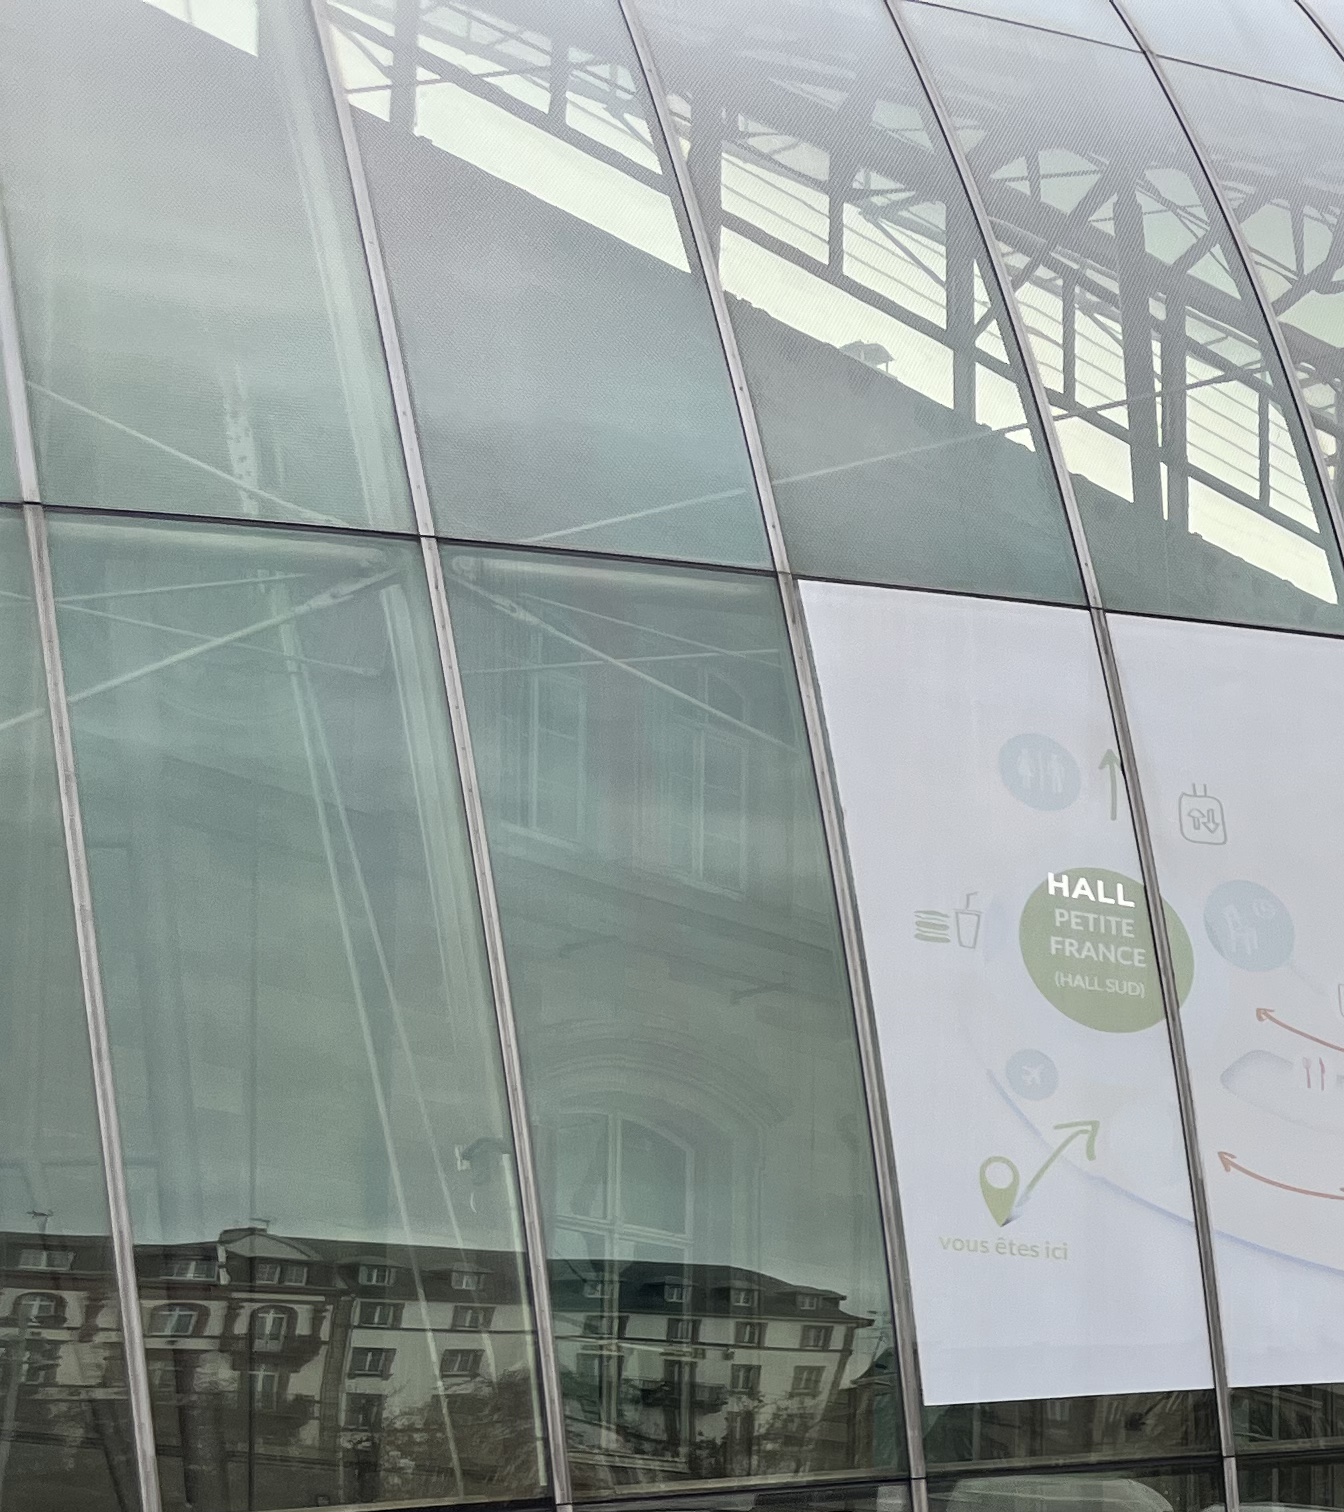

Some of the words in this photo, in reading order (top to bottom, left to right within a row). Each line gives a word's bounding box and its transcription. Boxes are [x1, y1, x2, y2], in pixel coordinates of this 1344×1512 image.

[1047, 872, 1135, 907] HALL
[1055, 909, 1135, 938] PETITE
[1050, 937, 1147, 967] FRANCE
[1054, 971, 1102, 991] (HALL
[1105, 978, 1146, 999] SUD)
[939, 1235, 990, 1254] vous
[995, 1236, 1040, 1257] êtes
[1044, 1240, 1069, 1260] ici
